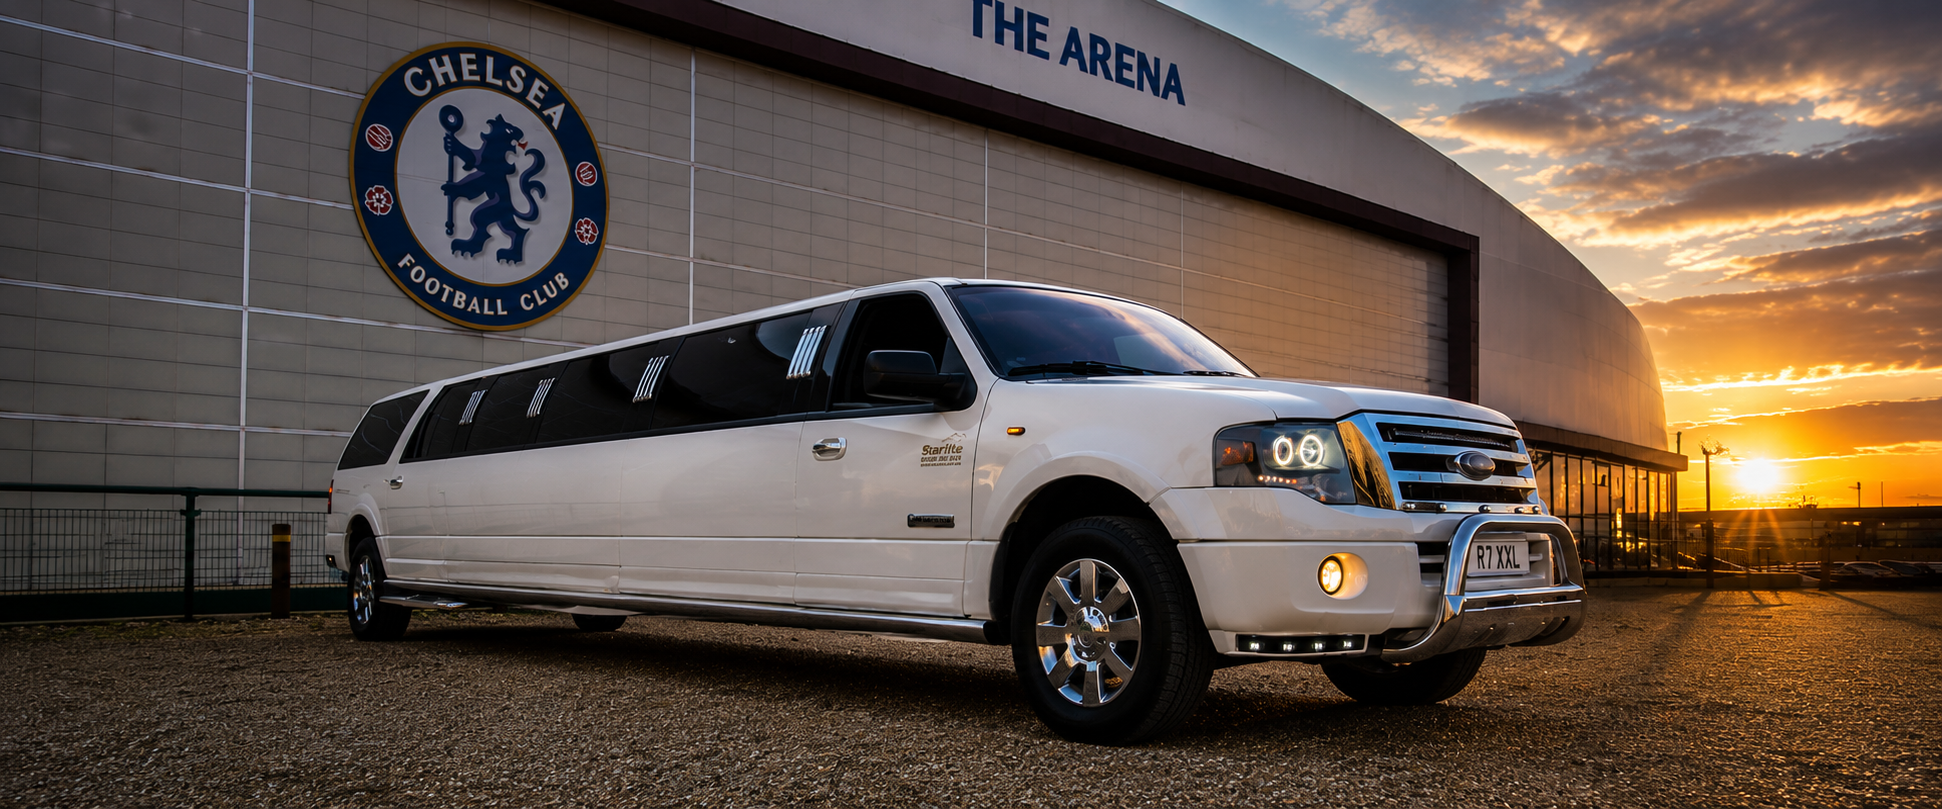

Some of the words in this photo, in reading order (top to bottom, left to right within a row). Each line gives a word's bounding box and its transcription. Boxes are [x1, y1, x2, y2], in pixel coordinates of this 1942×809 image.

[972, 0, 1050, 61] THE
[1059, 26, 1186, 107] ARENA
[404, 53, 566, 130] CHELSEA
[398, 253, 508, 315] FOOTBALL
[520, 272, 570, 312] CLUB
[1477, 545, 1492, 569] R7
[1496, 545, 1521, 569] XXL
